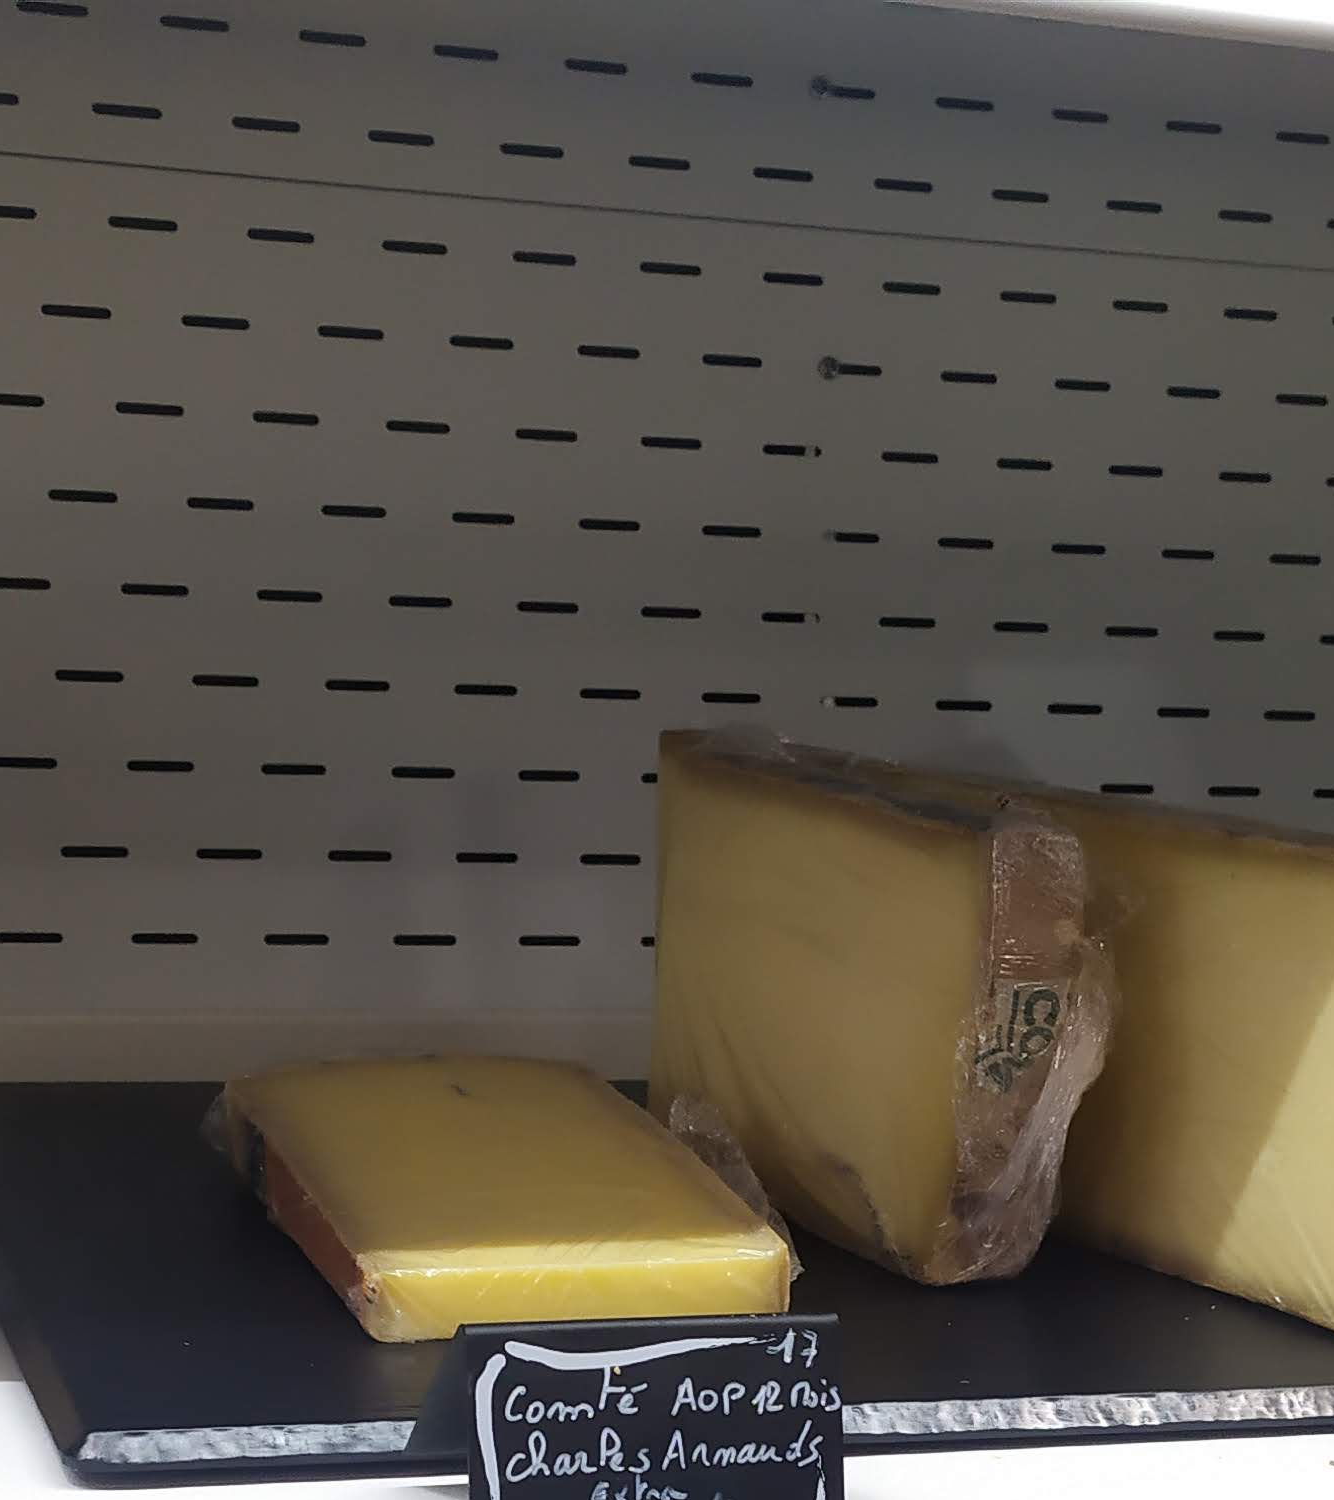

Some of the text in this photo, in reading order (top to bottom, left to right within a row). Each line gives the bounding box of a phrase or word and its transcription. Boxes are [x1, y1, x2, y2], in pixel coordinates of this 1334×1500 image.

[767, 1327, 819, 1369] 17
[504, 1366, 648, 1424] Comté
[670, 1377, 745, 1418] AOP
